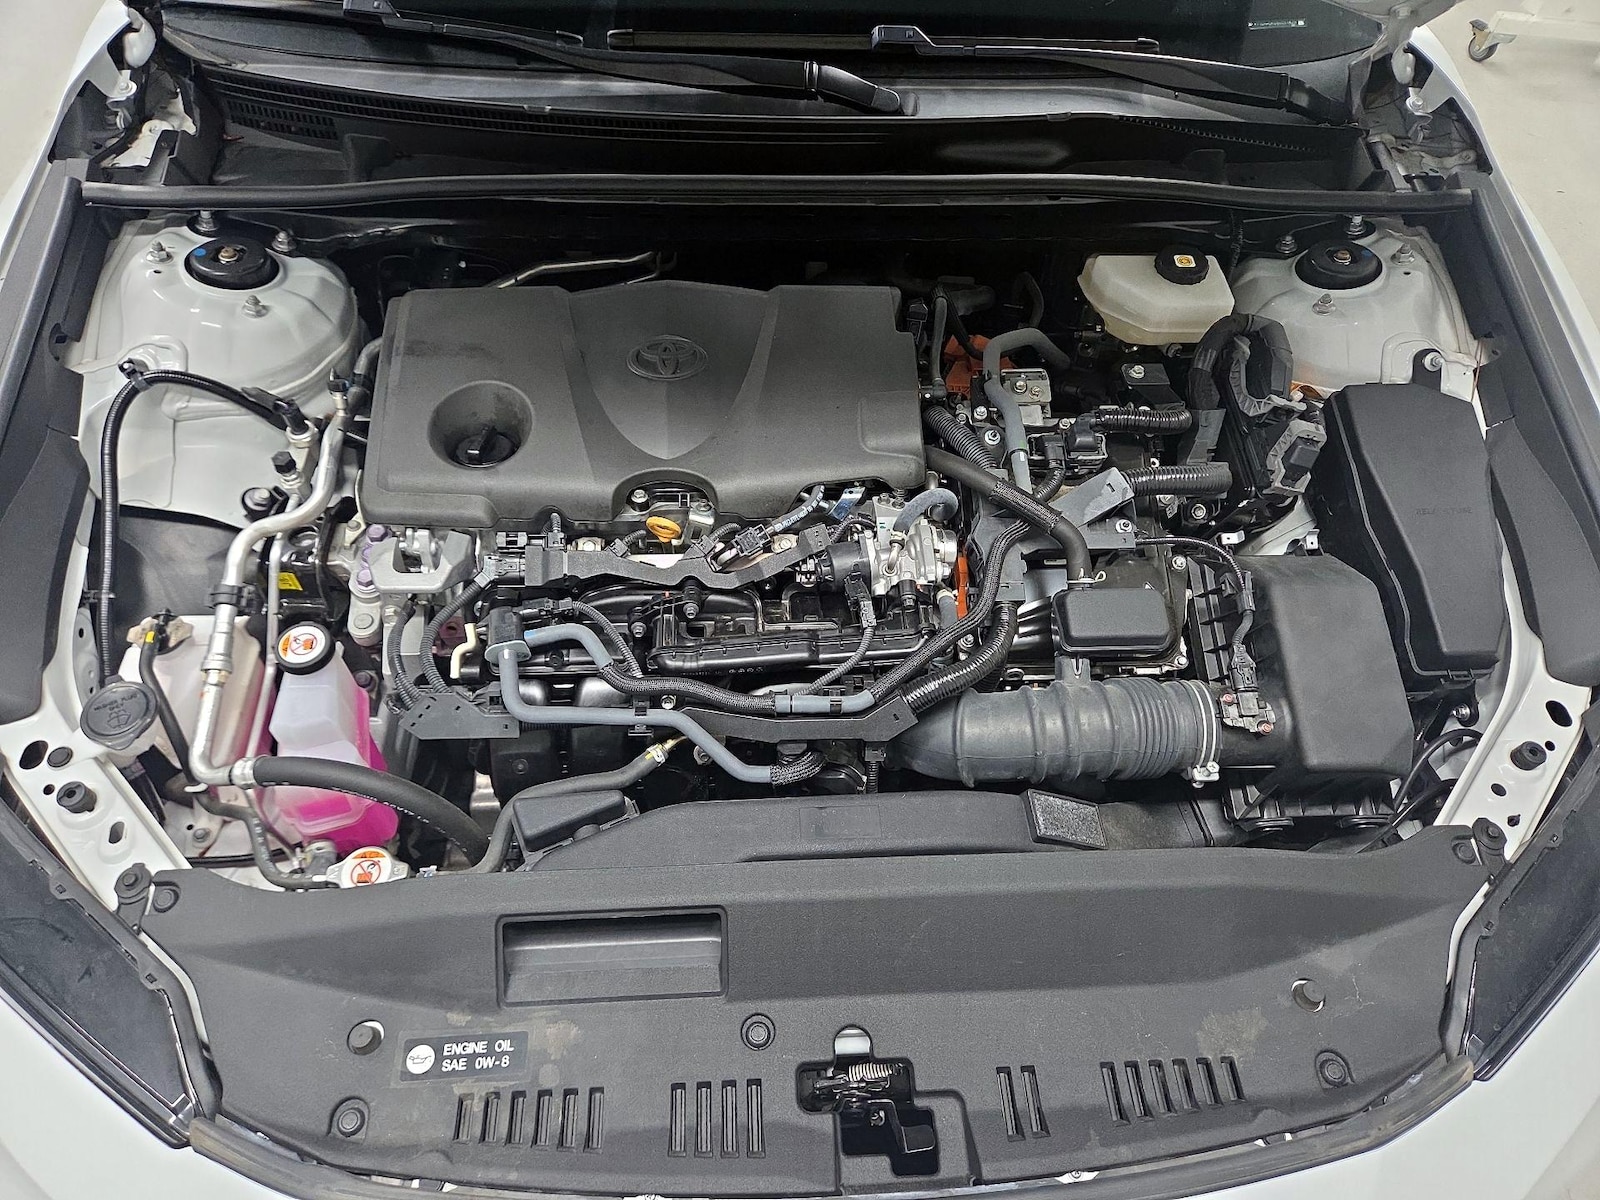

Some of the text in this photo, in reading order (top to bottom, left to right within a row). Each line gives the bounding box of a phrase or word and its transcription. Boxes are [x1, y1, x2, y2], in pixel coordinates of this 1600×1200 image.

[443, 1039, 514, 1056] ENGINE OIL
[441, 1055, 510, 1072] SAE 0W-8
